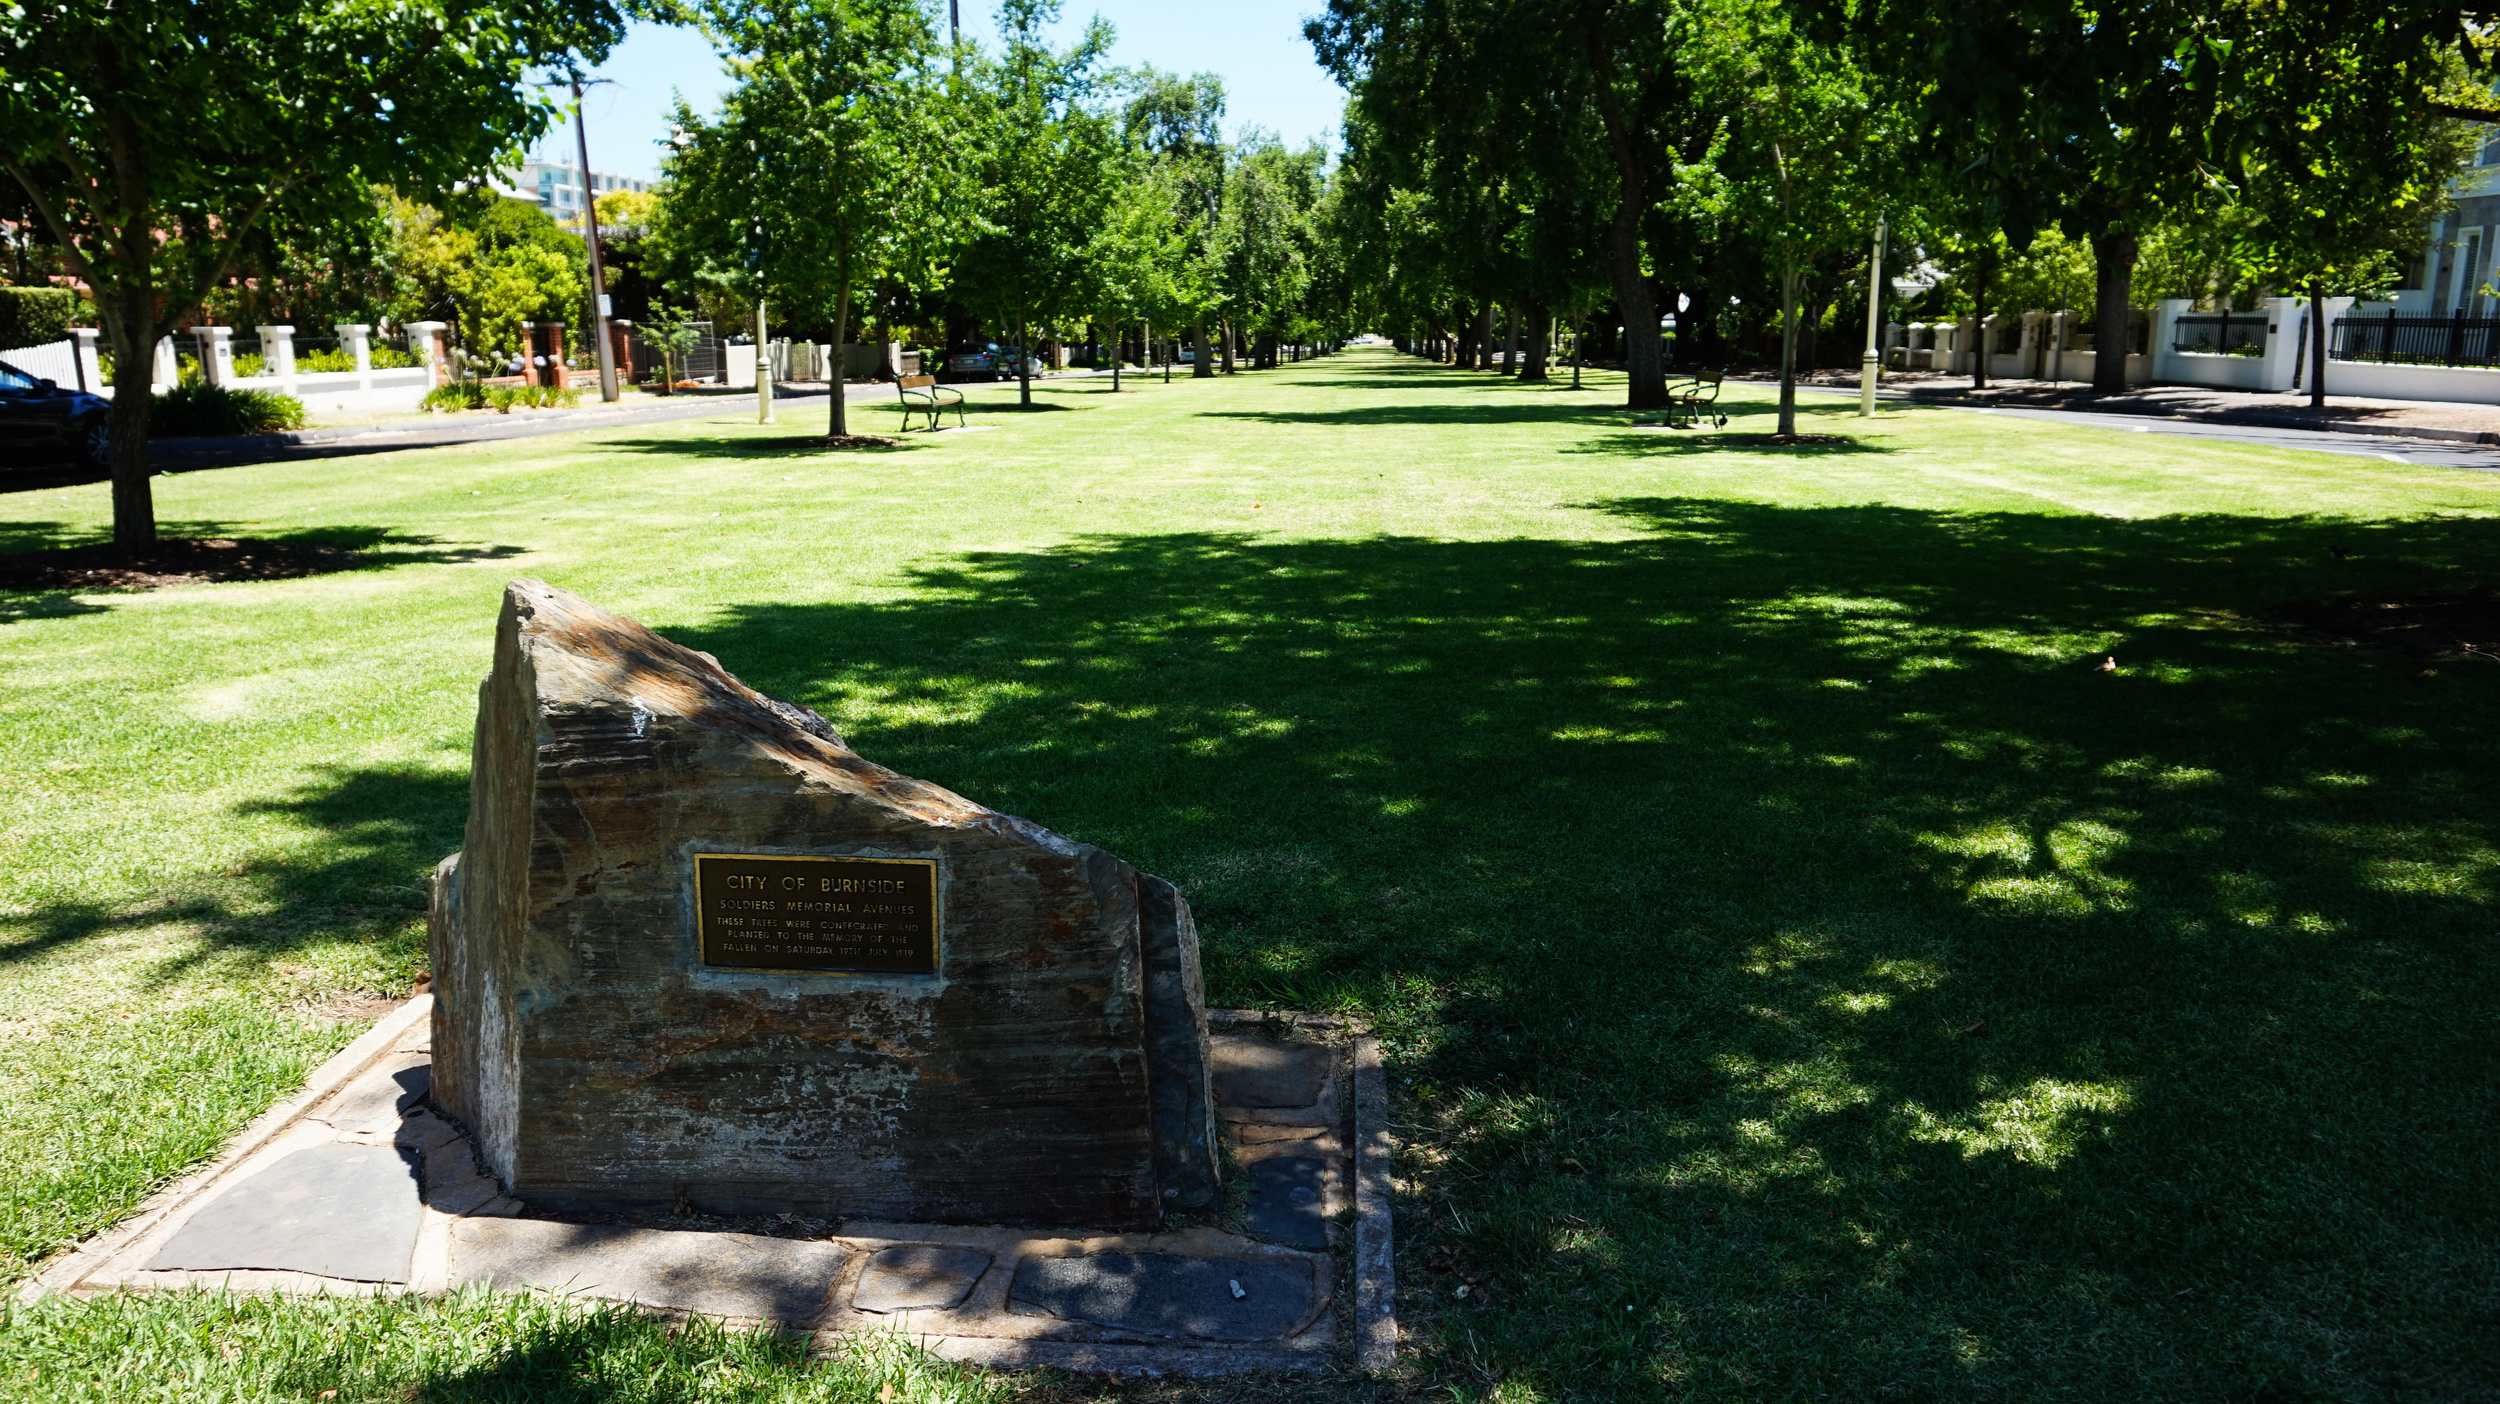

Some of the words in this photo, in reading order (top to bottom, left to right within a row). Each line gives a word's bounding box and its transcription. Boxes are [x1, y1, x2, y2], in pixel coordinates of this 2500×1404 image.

[726, 875, 767, 890] CITY
[781, 876, 805, 891] OF
[821, 877, 905, 894] BURNSIDE
[720, 899, 776, 910] SOLDIERS
[787, 901, 852, 913] MEMORIAL
[862, 904, 915, 915] AVENUES
[717, 917, 744, 926] THESE
[751, 918, 778, 927] TREES
[786, 920, 811, 928] WERE
[820, 921, 889, 931] CONSECRATED
[897, 924, 919, 932] AND
[728, 930, 770, 939] PLANTED
[777, 932, 790, 940] TO
[797, 932, 814, 940] THE
[822, 933, 864, 942] MEMORY
[870, 935, 883, 943] OF
[891, 935, 908, 944] THE
[723, 943, 757, 952] FALLEN
[764, 944, 779, 952] ON
[840, 947, 861, 955] 19TH
[896, 949, 914, 957] 1919
